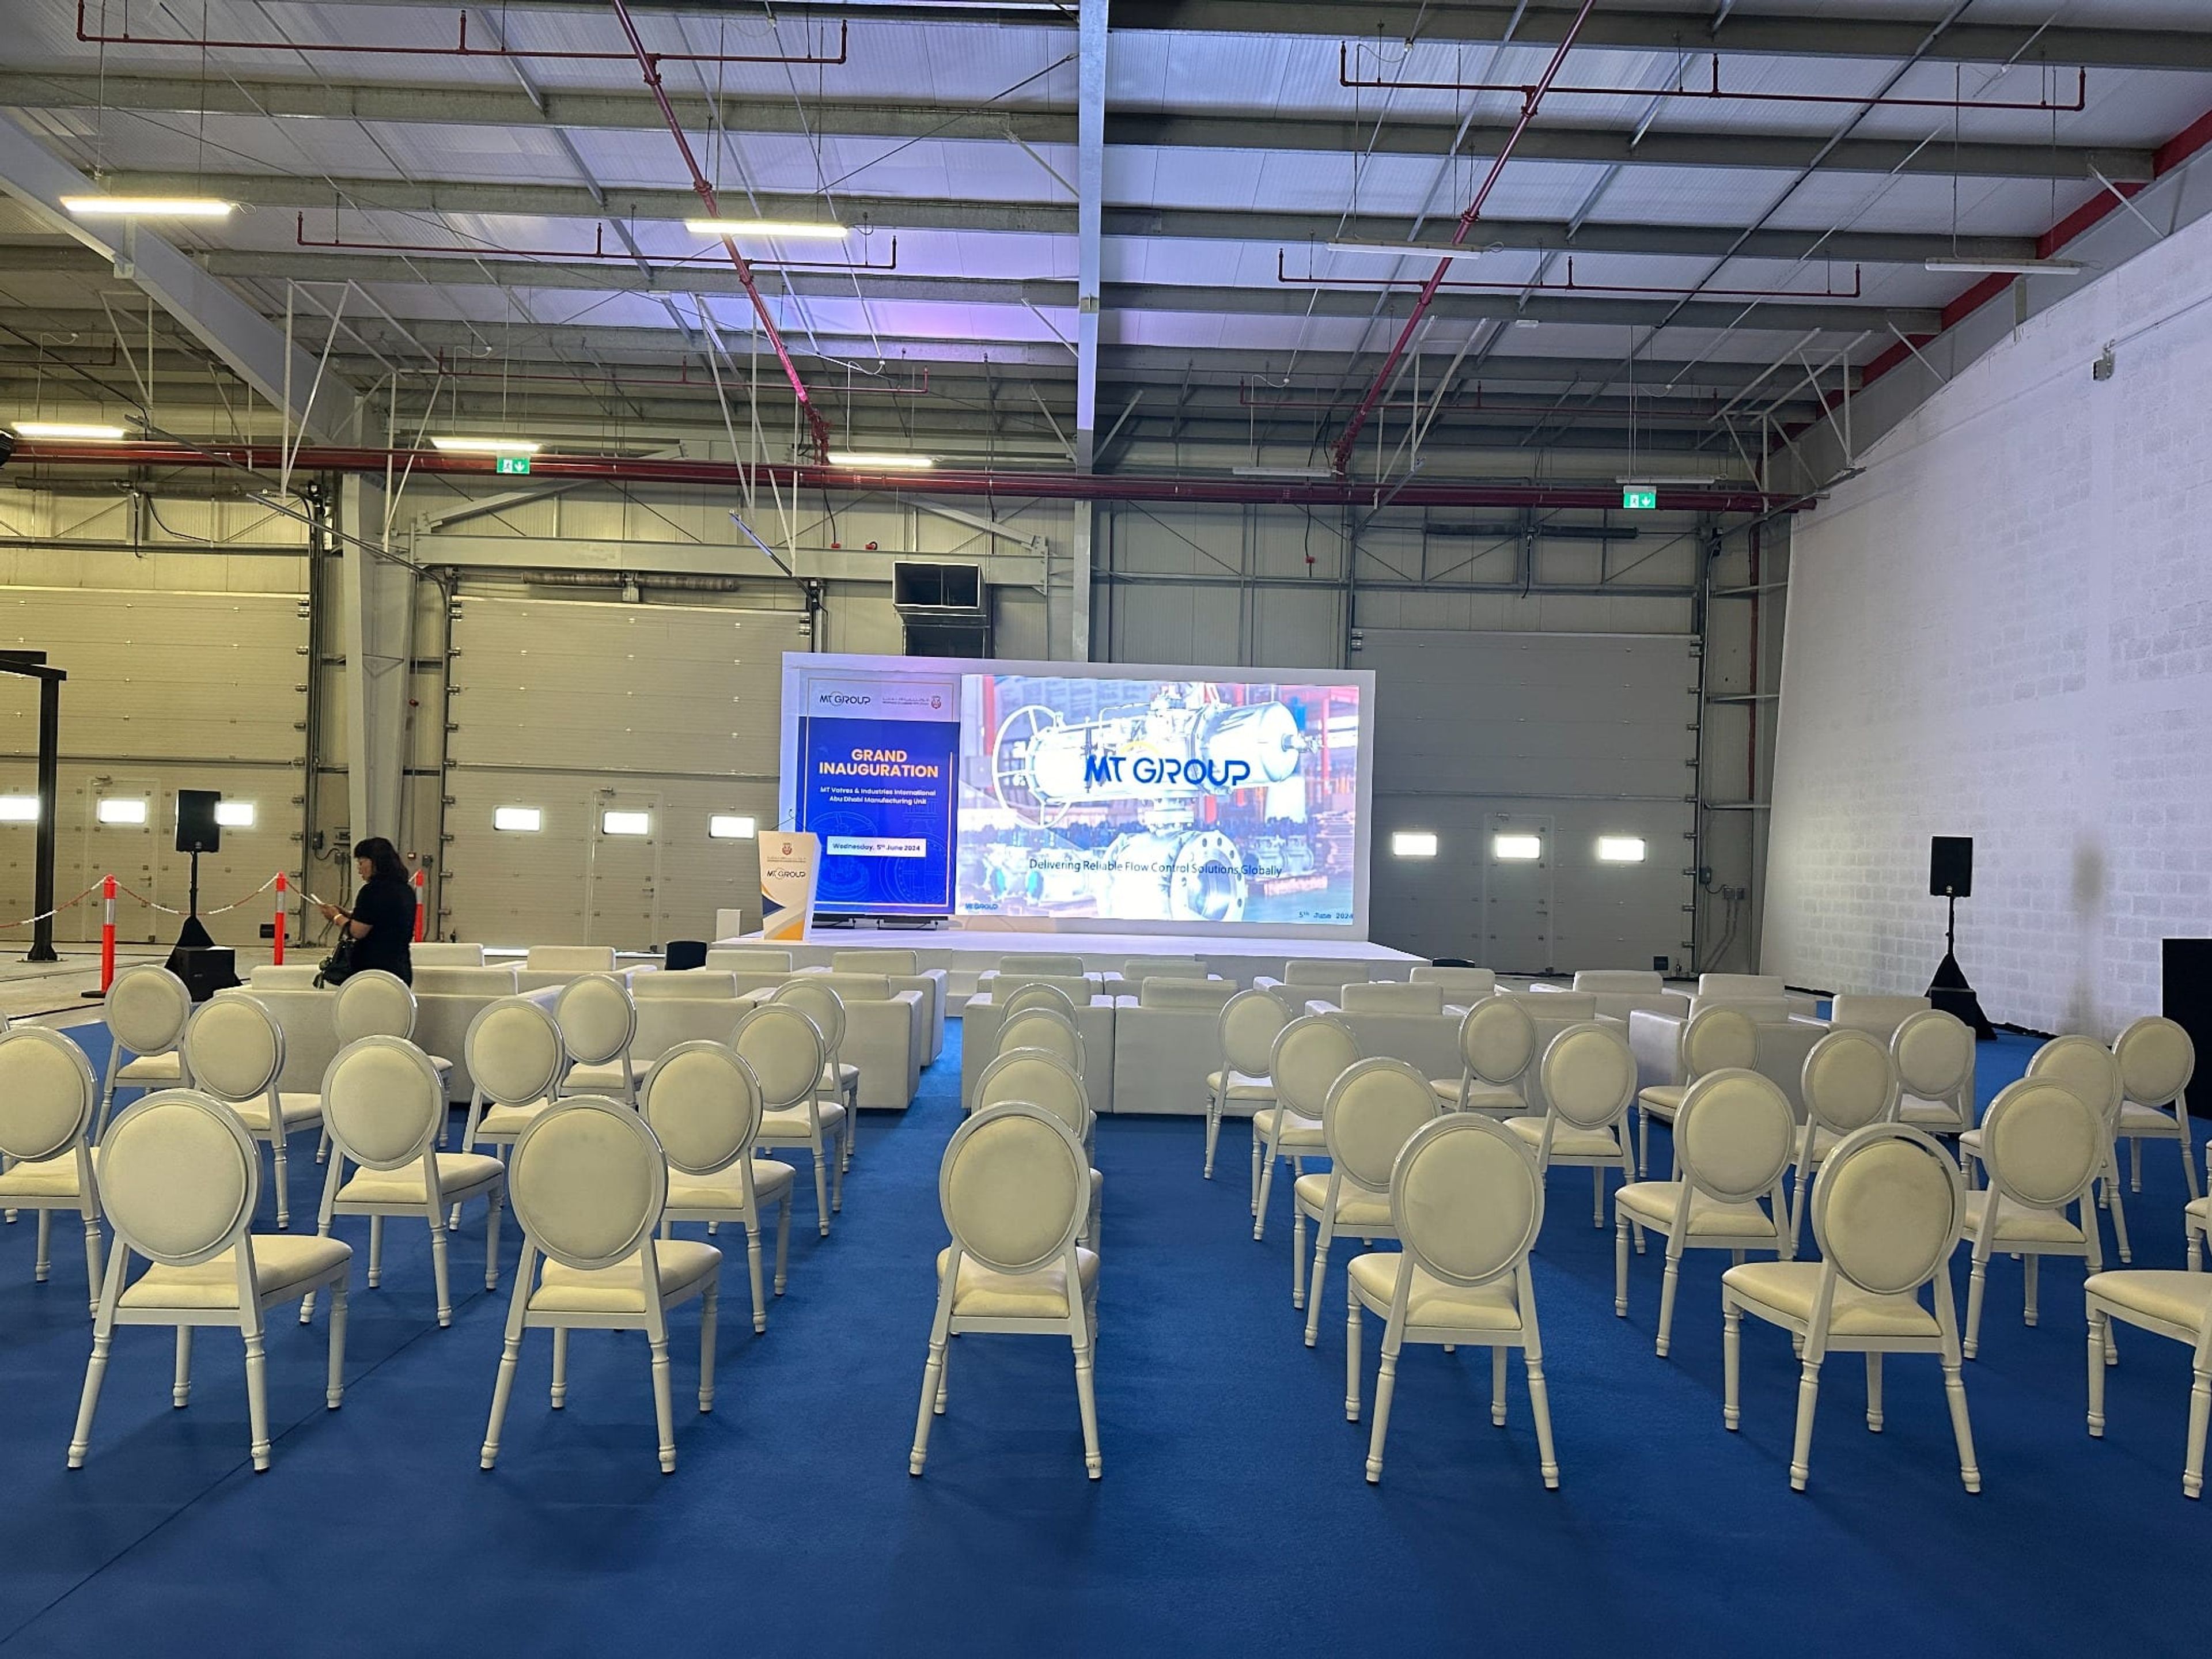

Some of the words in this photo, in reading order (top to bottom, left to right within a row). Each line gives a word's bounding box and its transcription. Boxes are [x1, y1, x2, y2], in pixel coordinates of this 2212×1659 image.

[820, 695, 832, 703] MT
[835, 695, 870, 704] GROUP
[851, 749, 907, 762] GRAND
[819, 762, 938, 778] INAUGURATION
[1084, 753, 1126, 782] MT
[1133, 757, 1251, 786] GROUP
[864, 797, 912, 805] Manufacturing
[833, 843, 874, 851] Wednesday,
[1029, 859, 1081, 872] Delivering
[1084, 861, 1123, 870] Reliable
[1126, 862, 1149, 871] Flow
[1151, 863, 1189, 873] Control
[1191, 863, 1238, 874] Solutions
[1241, 865, 1282, 877] Globally
